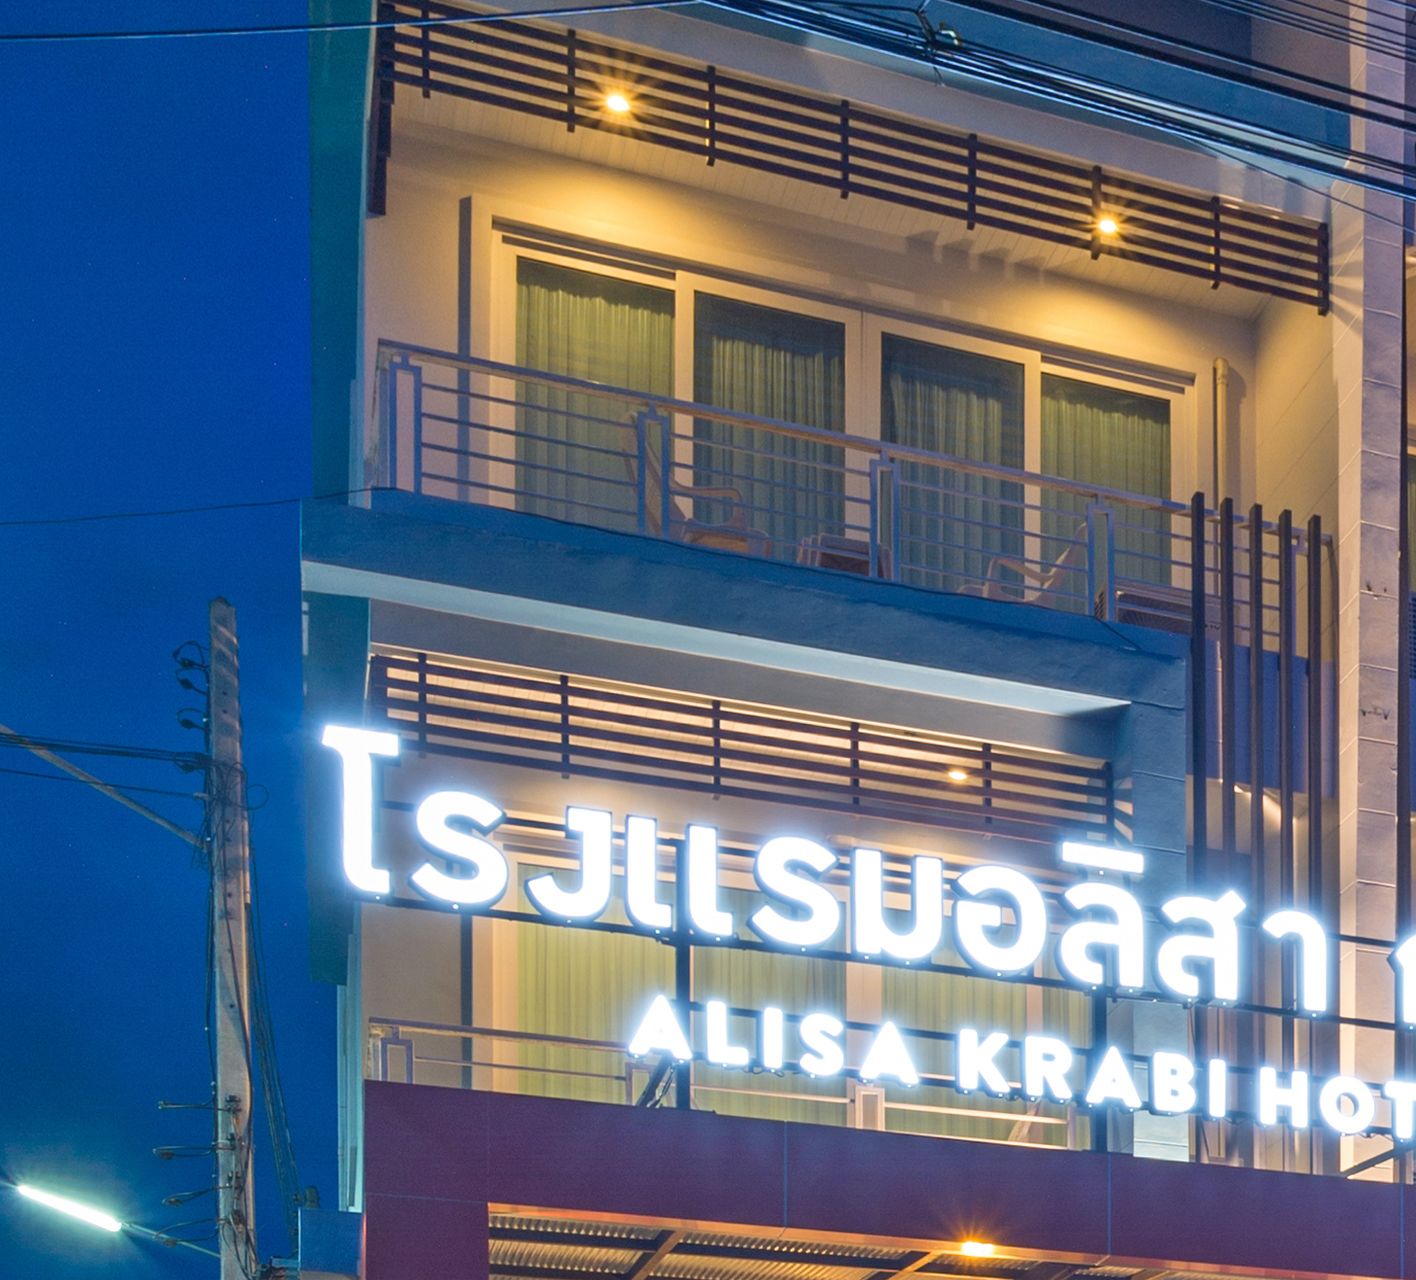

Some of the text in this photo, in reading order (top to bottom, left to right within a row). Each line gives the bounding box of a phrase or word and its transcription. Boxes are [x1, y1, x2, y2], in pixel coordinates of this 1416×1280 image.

[322, 724, 1328, 1012] โรงแรมอลิสา
[626, 994, 921, 1088] ALISA
[957, 1027, 1227, 1118] KRABI
